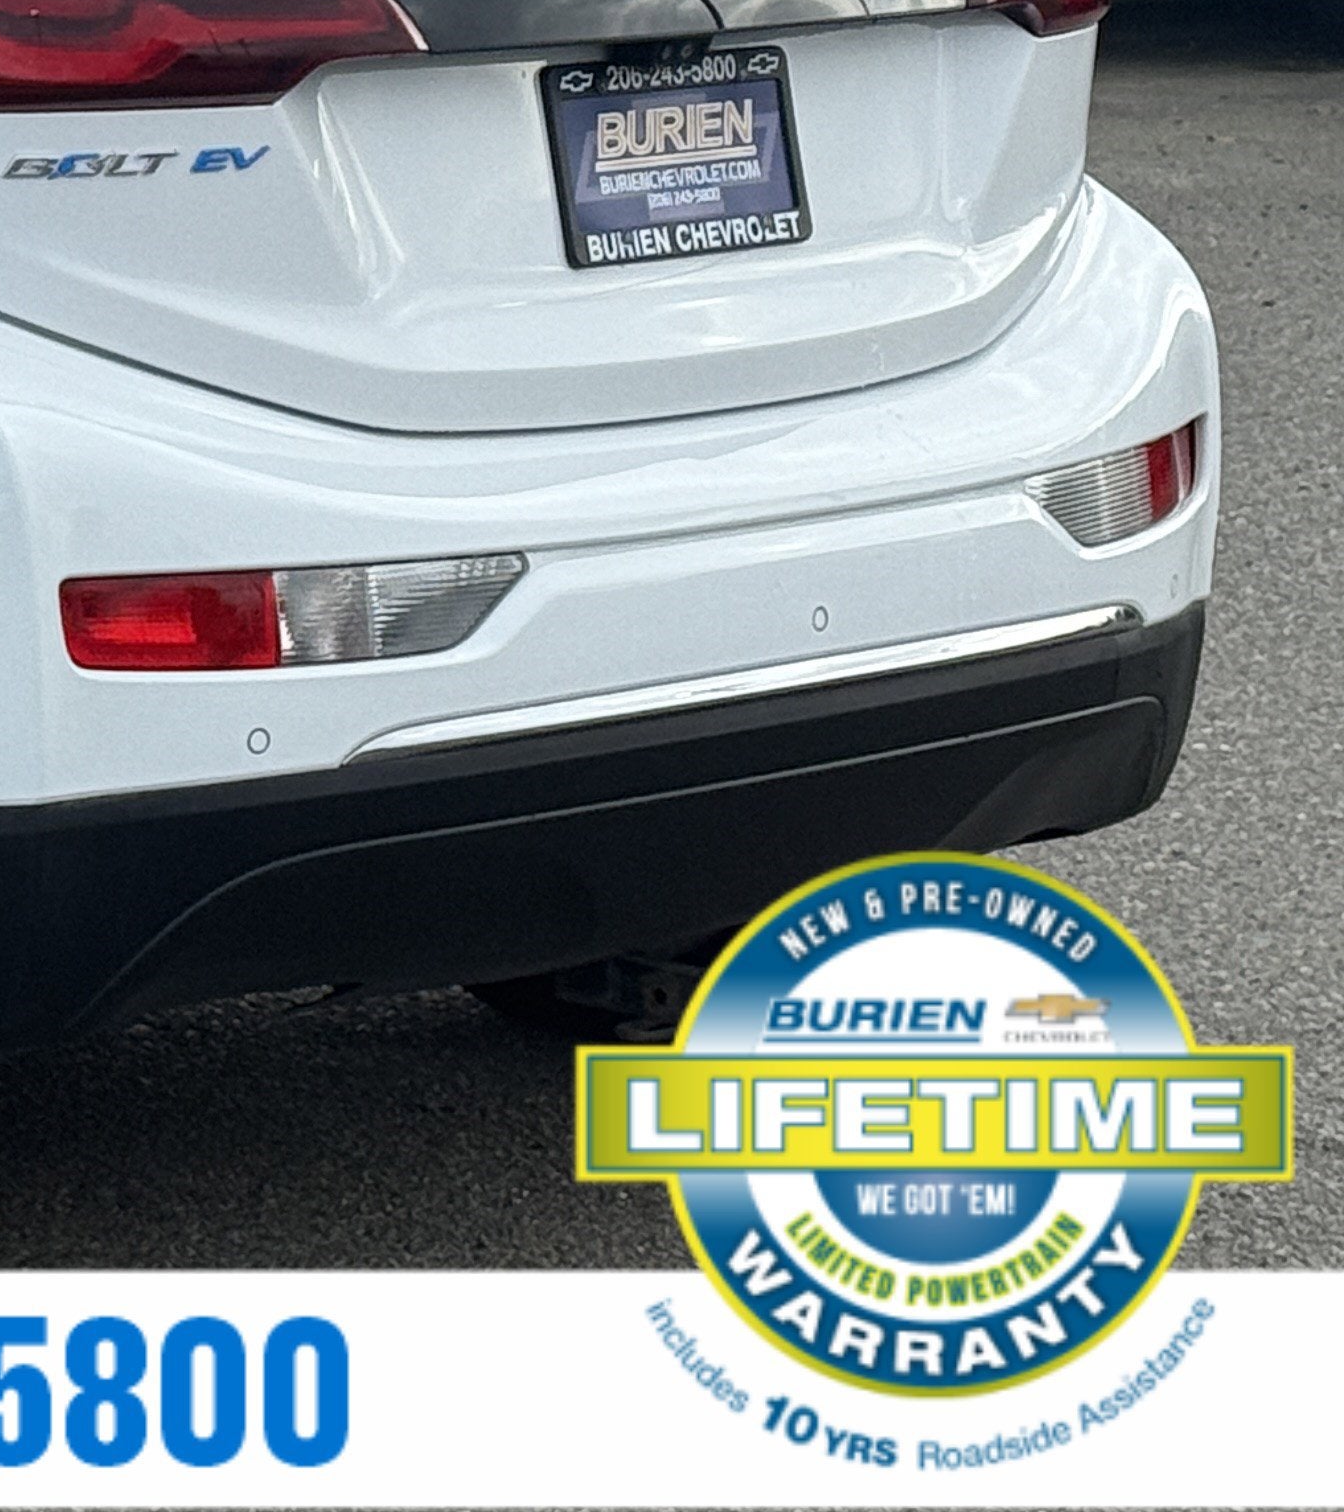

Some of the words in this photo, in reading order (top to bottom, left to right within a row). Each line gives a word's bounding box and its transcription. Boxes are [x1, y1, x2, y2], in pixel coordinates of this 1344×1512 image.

[606, 54, 737, 91] 206-243-5800
[596, 99, 754, 158] BURIEN
[1, 149, 180, 180] BOLT
[190, 144, 271, 175] EV
[598, 158, 762, 196] BURIENCHEVROLET.COM
[586, 224, 673, 263] BURIEN
[673, 210, 802, 253] CHEVROLET
